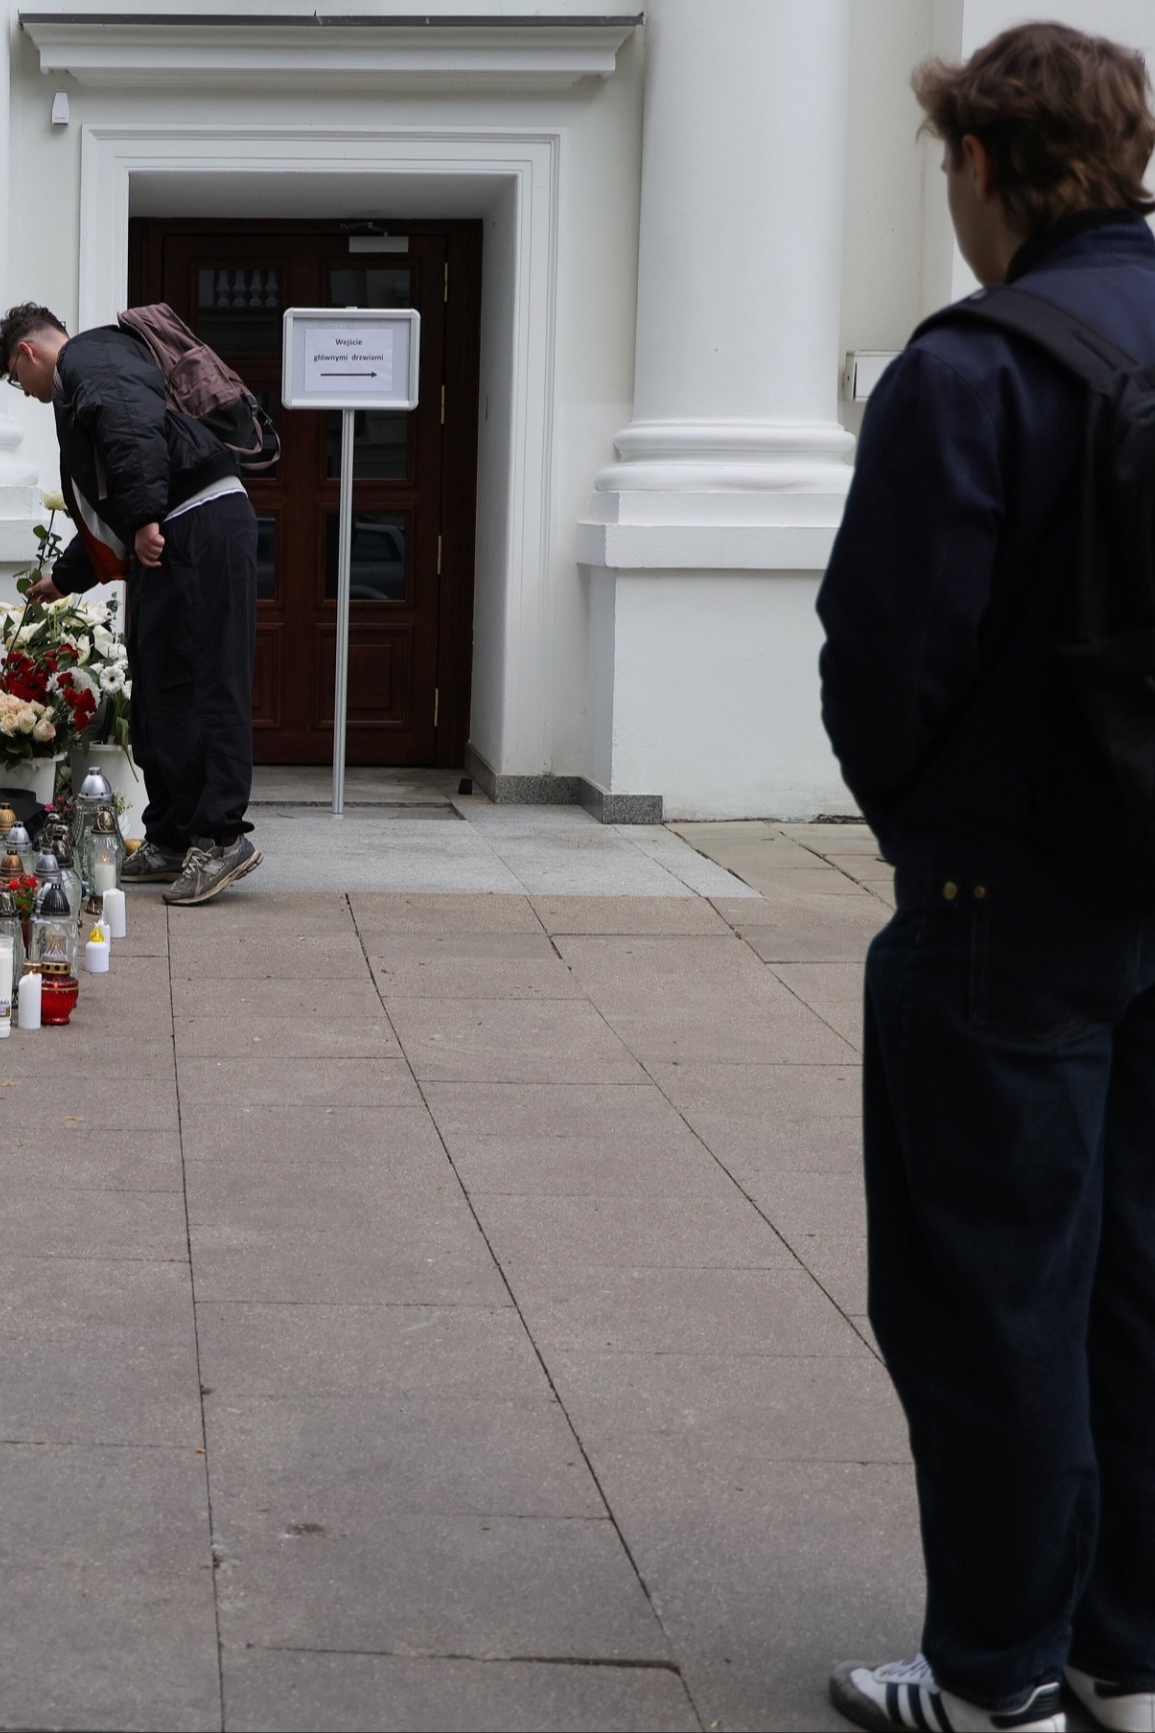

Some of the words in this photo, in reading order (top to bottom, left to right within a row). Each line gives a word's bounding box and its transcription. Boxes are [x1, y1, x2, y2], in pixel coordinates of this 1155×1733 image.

[335, 338, 363, 347] Wejście
[313, 353, 349, 362] głównymi
[351, 353, 384, 361] drzwiami
